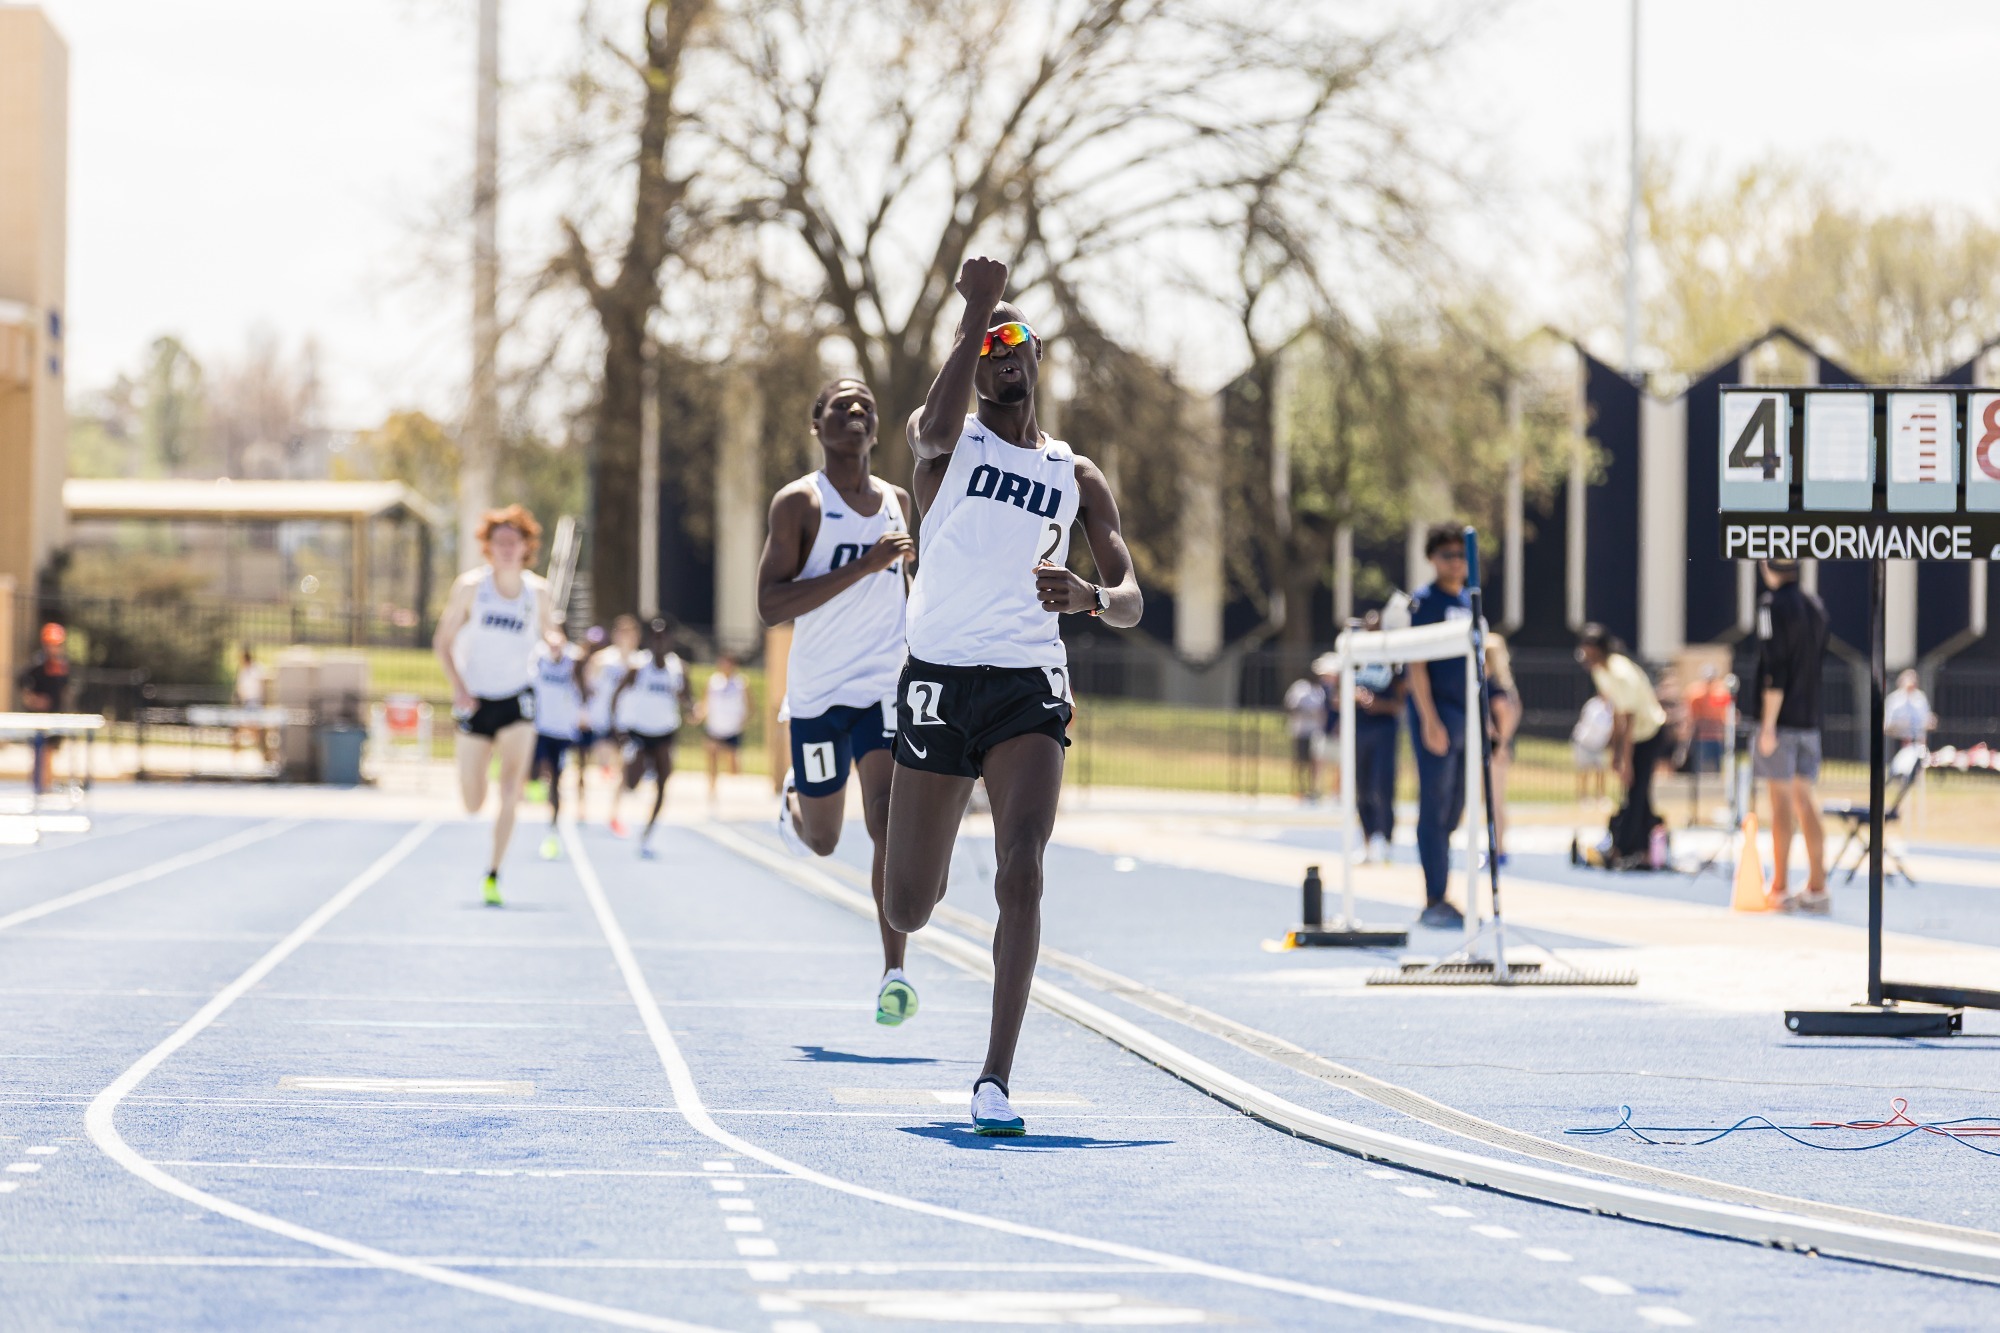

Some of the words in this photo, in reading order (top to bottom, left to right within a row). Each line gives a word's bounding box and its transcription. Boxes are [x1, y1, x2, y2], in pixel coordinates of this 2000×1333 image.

[1728, 398, 1781, 479] 4
[966, 463, 1062, 519] ORU
[1038, 523, 1062, 566] 2
[1726, 525, 1972, 560] PERFORMANCE
[915, 684, 941, 723] 2
[812, 747, 826, 778] 1
